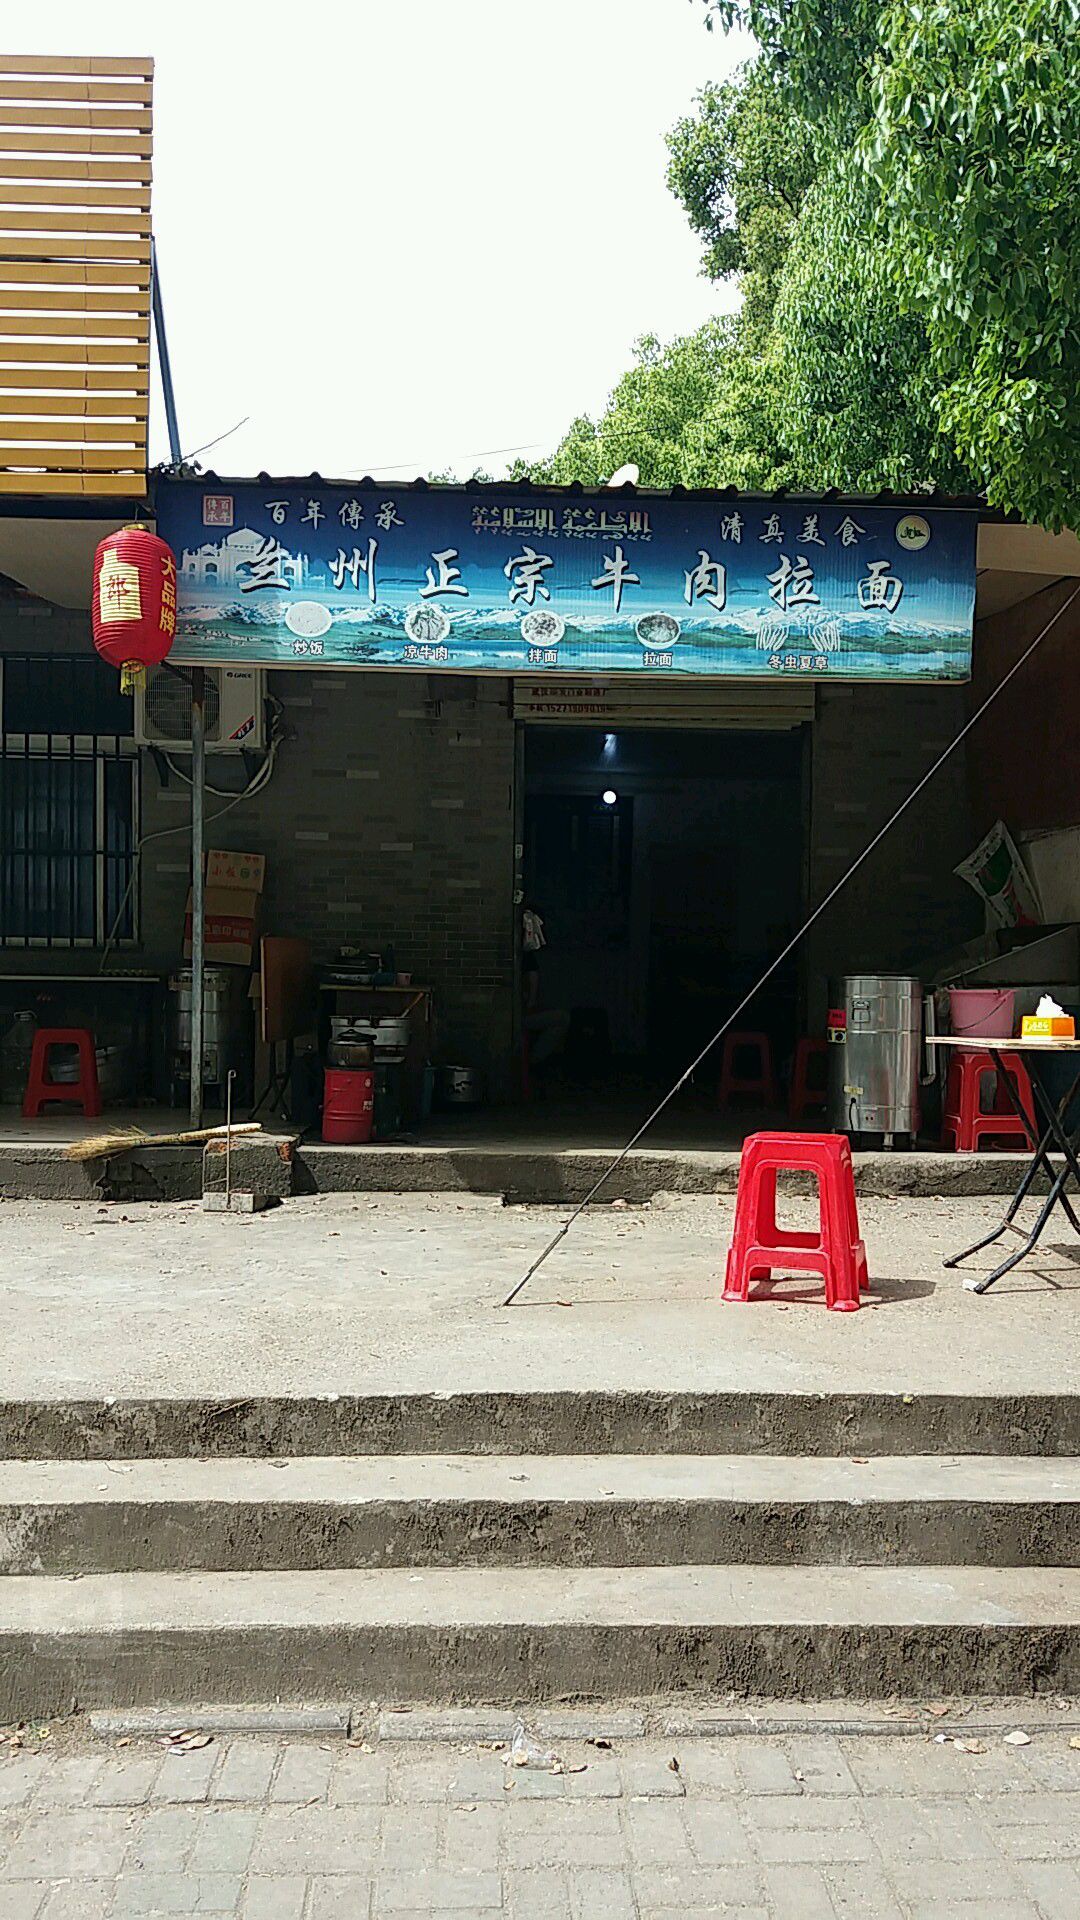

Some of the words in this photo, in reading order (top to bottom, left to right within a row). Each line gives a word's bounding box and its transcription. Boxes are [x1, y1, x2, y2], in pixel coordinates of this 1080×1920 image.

[720, 510, 867, 546] 清真美食
[240, 536, 905, 612] 兰州正宗牛肉拉面
[159, 555, 176, 637] 大品牌
[293, 639, 325, 656] 炒饭
[403, 644, 449, 661] 凉牛肉
[528, 647, 558, 664] 拌面
[643, 651, 673, 667] 拉面
[768, 654, 829, 671] 冬虫夏草
